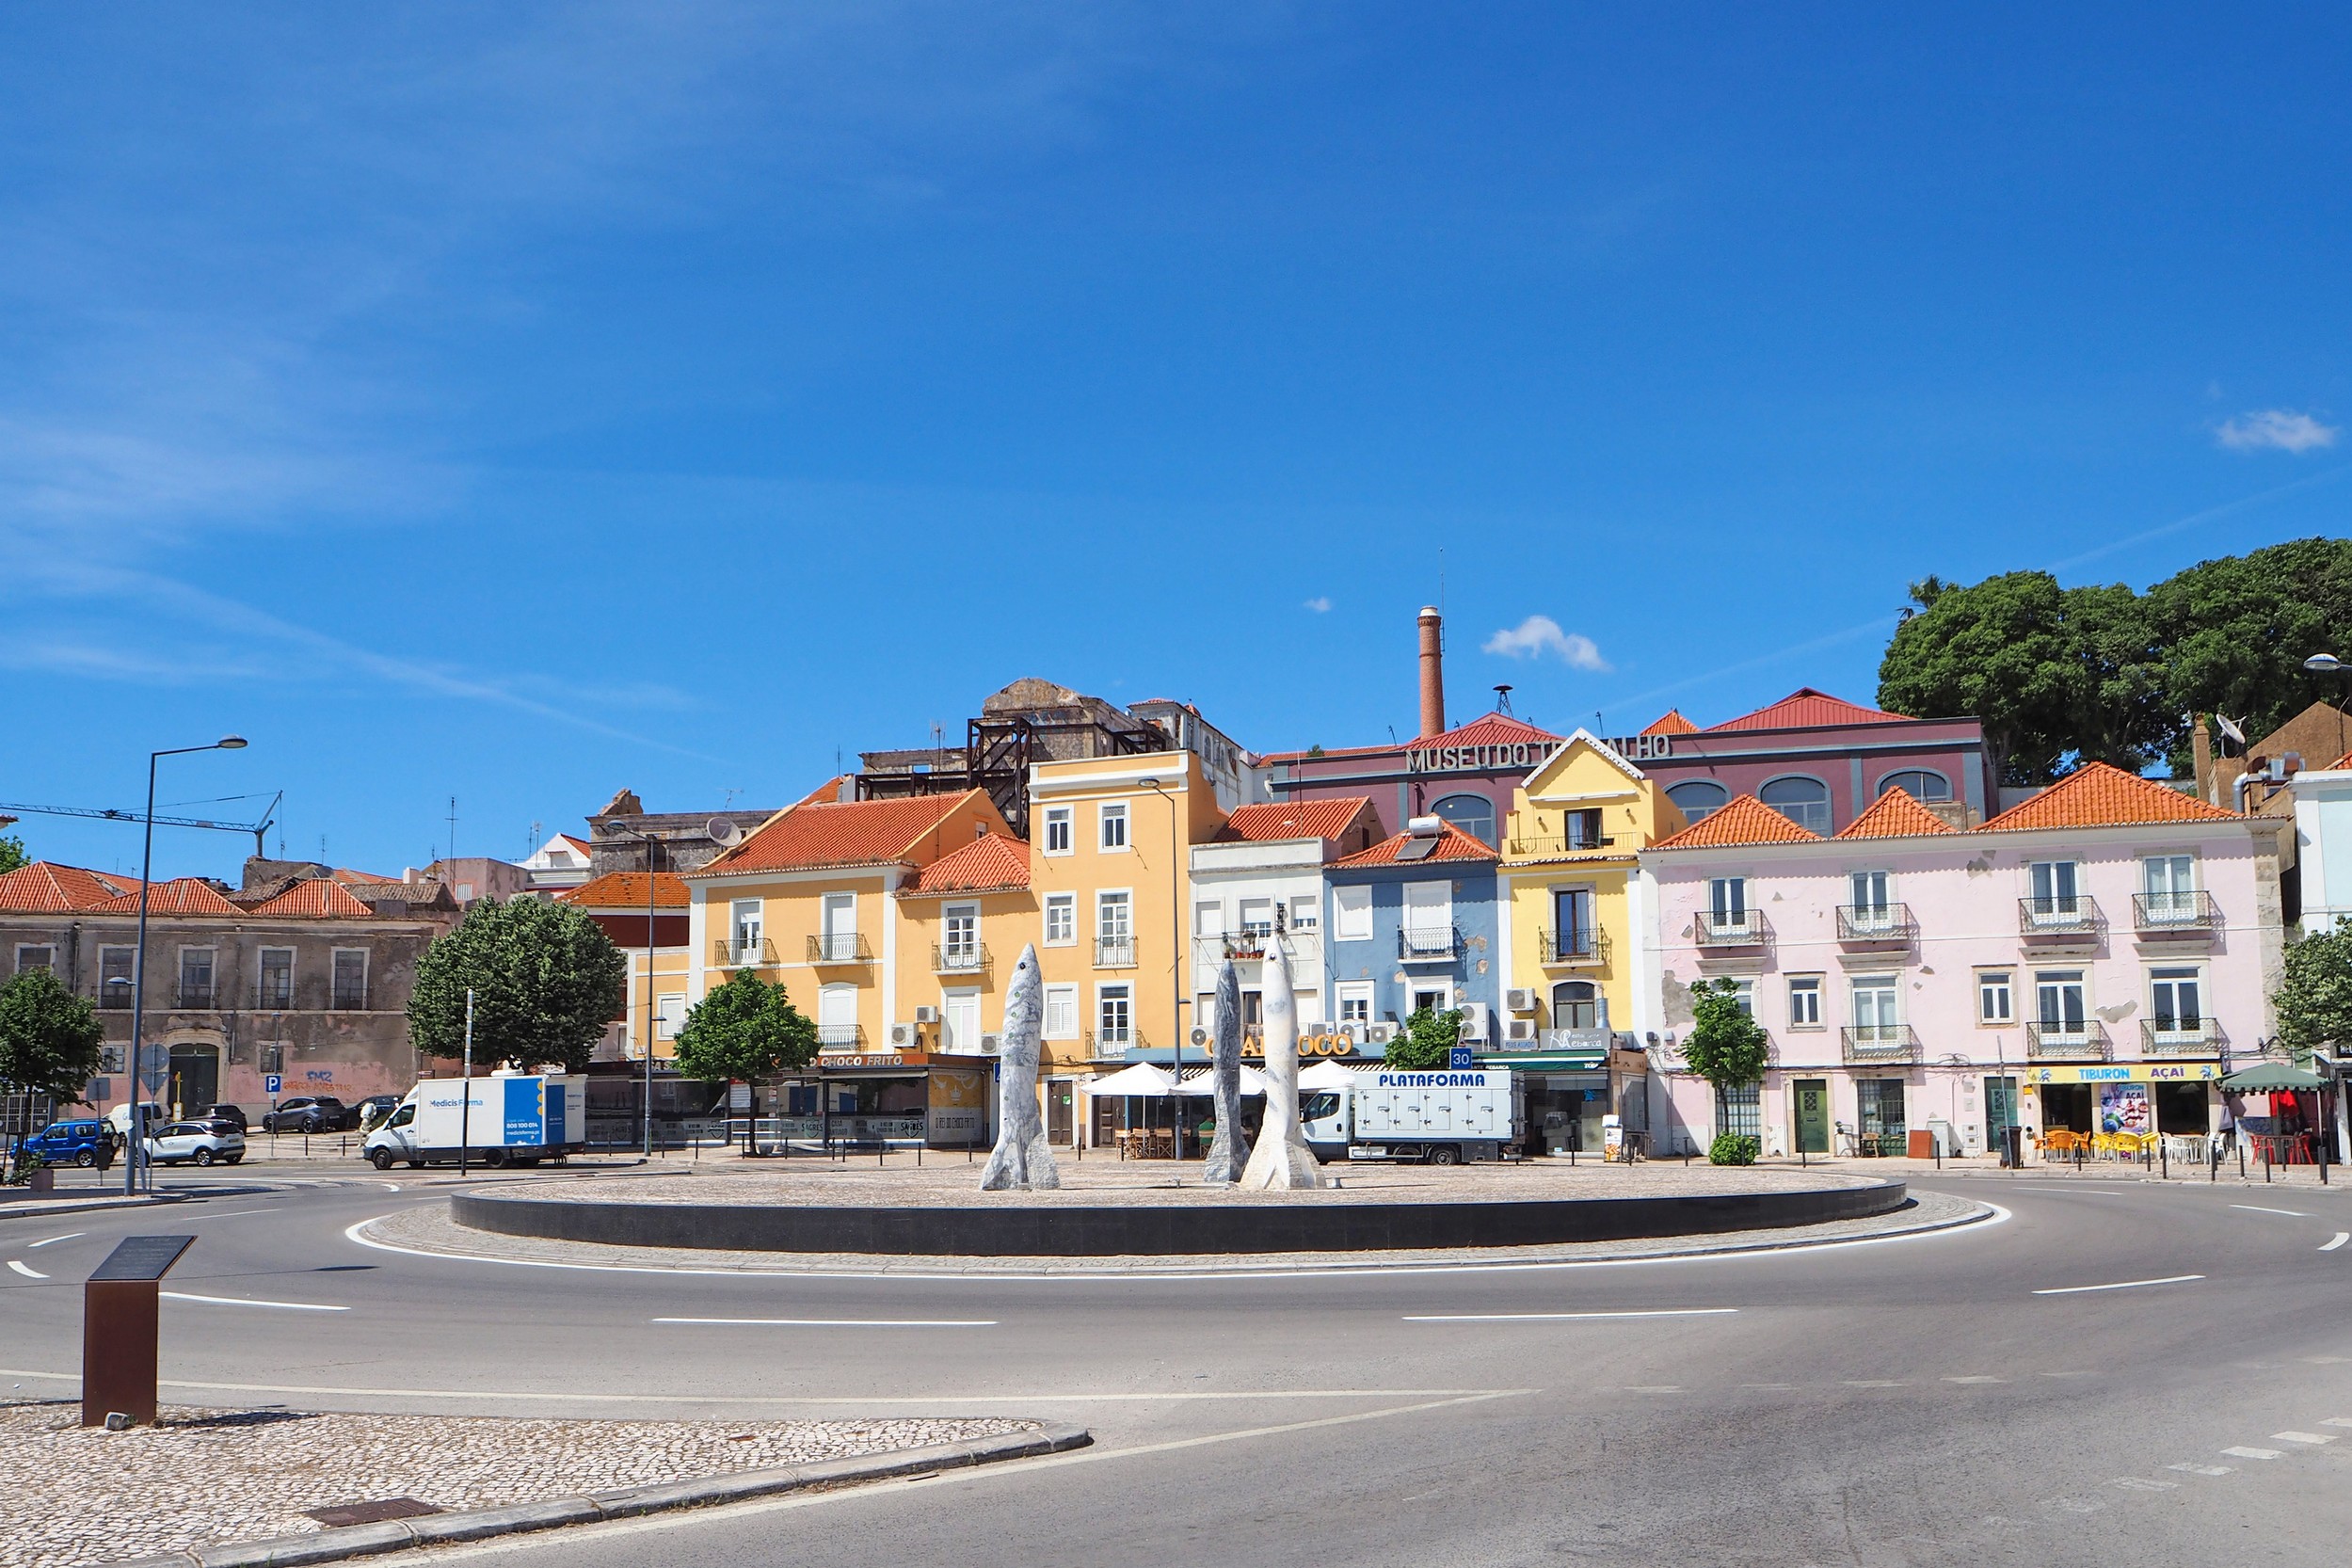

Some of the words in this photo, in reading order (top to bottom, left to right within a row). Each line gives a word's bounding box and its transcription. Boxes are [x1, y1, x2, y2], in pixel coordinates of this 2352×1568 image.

[1405, 744, 1488, 772] MUSEU
[1502, 743, 1529, 767] DO
[1535, 735, 1670, 763] TALHO
[821, 1056, 862, 1066] CHOCO
[867, 1055, 903, 1065] FRITO
[1453, 1053, 1469, 1064] 30
[2079, 1068, 2130, 1080] TIBURON
[2151, 1066, 2184, 1080] AÇAÍ
[268, 1077, 278, 1091] P
[1379, 1074, 1485, 1087] PLATAFORMA
